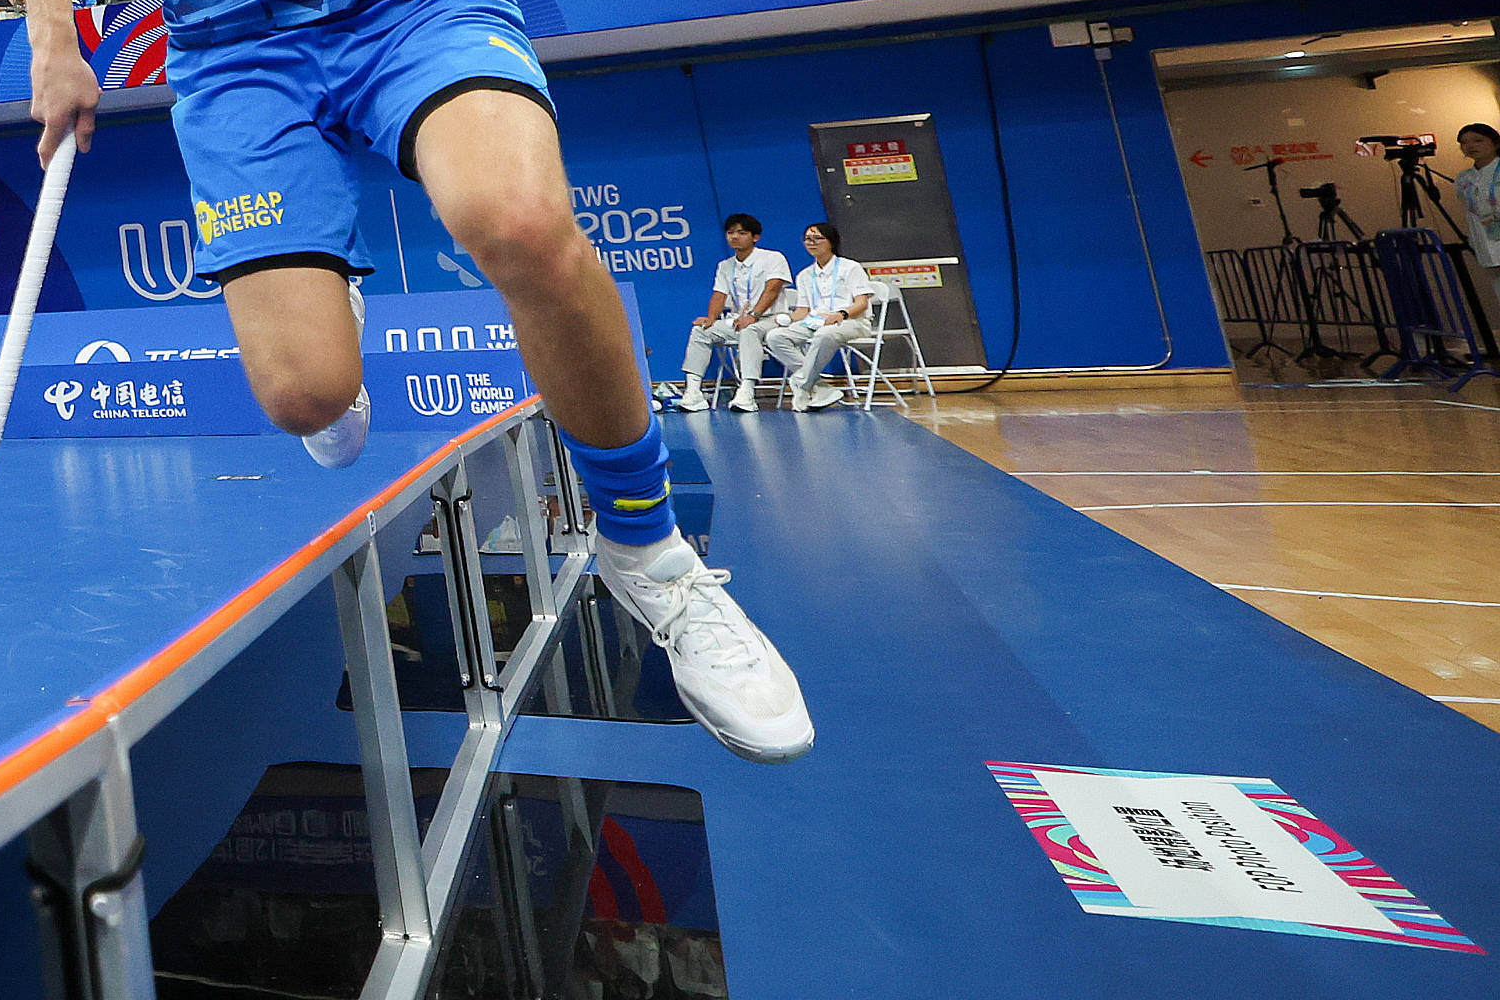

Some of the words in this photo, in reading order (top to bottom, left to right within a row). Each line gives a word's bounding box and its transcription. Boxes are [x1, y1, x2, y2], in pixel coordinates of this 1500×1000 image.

[216, 191, 283, 219] CHEAP
[571, 184, 620, 208] TWG
[212, 208, 284, 238] ENERGY
[575, 205, 691, 244] 2025
[601, 246, 693, 273] ENGDU
[484, 324, 514, 341] TH
[466, 373, 491, 386] THE
[91, 380, 186, 409] 中国电信
[468, 387, 514, 400] WORLD
[93, 408, 130, 419] CHINA
[131, 408, 187, 418] TELECOM
[1180, 801, 1244, 838] Position
[1218, 839, 1278, 869] Photo
[1245, 870, 1303, 893] FOP
